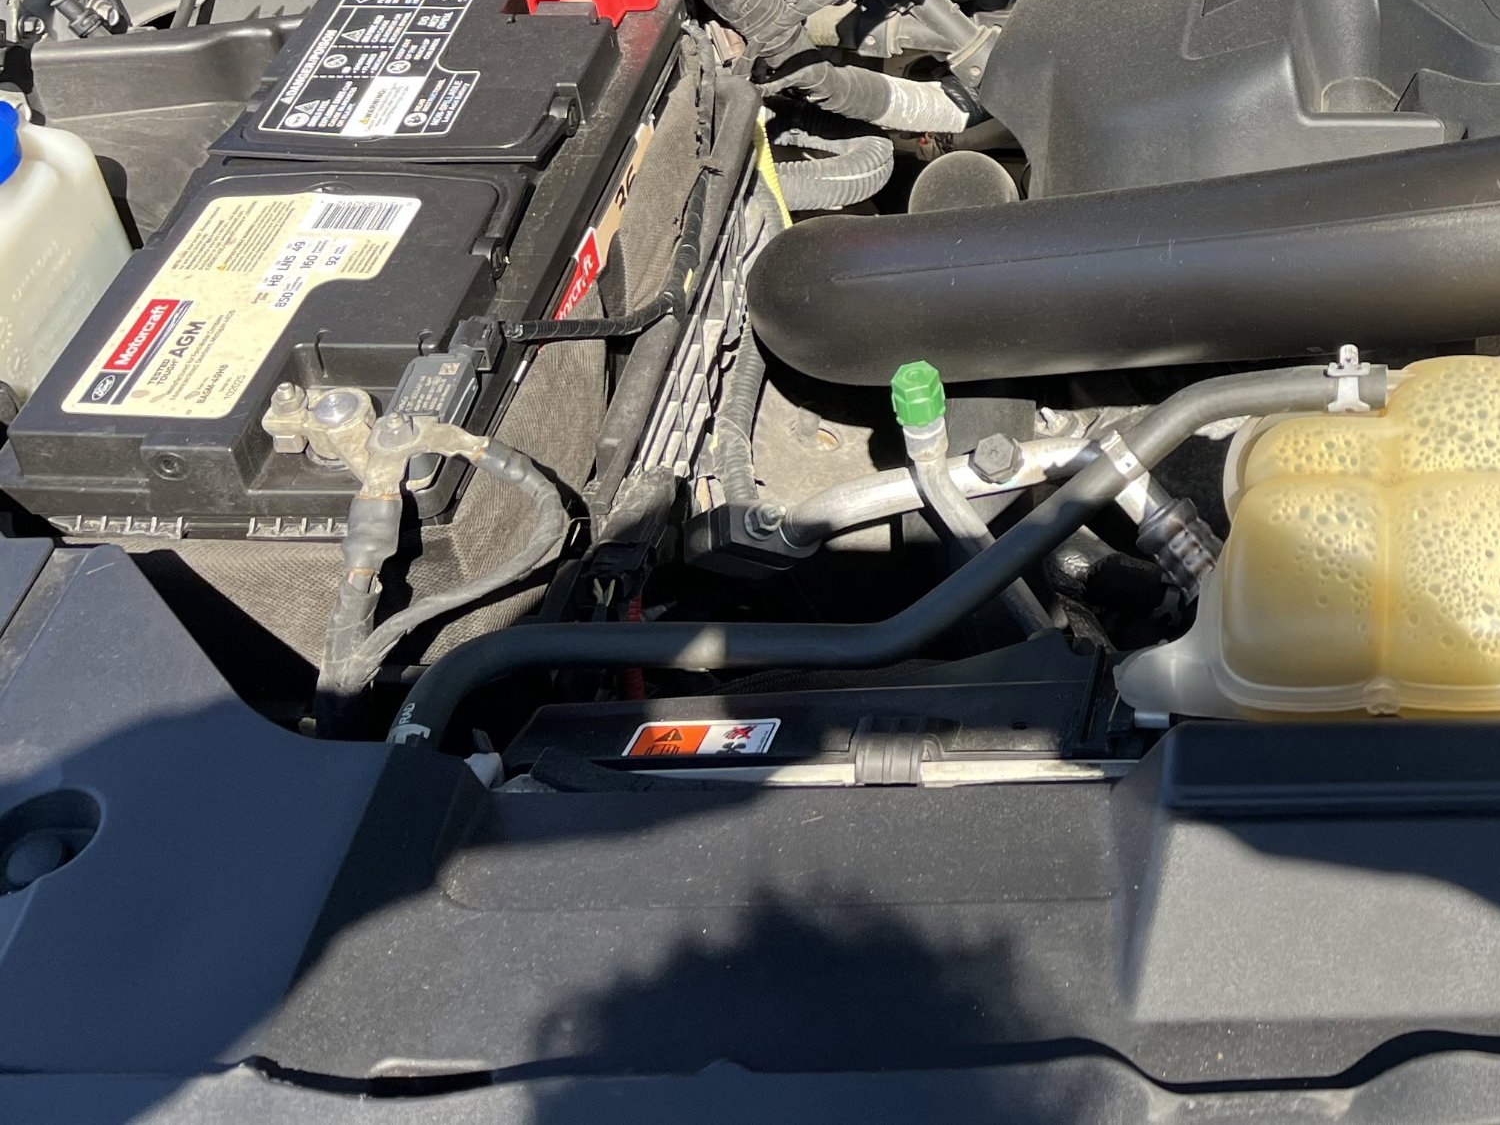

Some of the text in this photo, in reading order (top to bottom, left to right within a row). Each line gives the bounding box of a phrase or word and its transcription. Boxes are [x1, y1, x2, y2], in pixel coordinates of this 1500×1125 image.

[292, 241, 305, 251] 49
[300, 255, 318, 268] 160
[325, 256, 340, 265] 92
[115, 306, 167, 364] Motorcraft
[169, 322, 205, 357] AGM
[147, 359, 170, 384] TESTED
[156, 361, 178, 384] TOUGH
[224, 375, 245, 399] 102025
